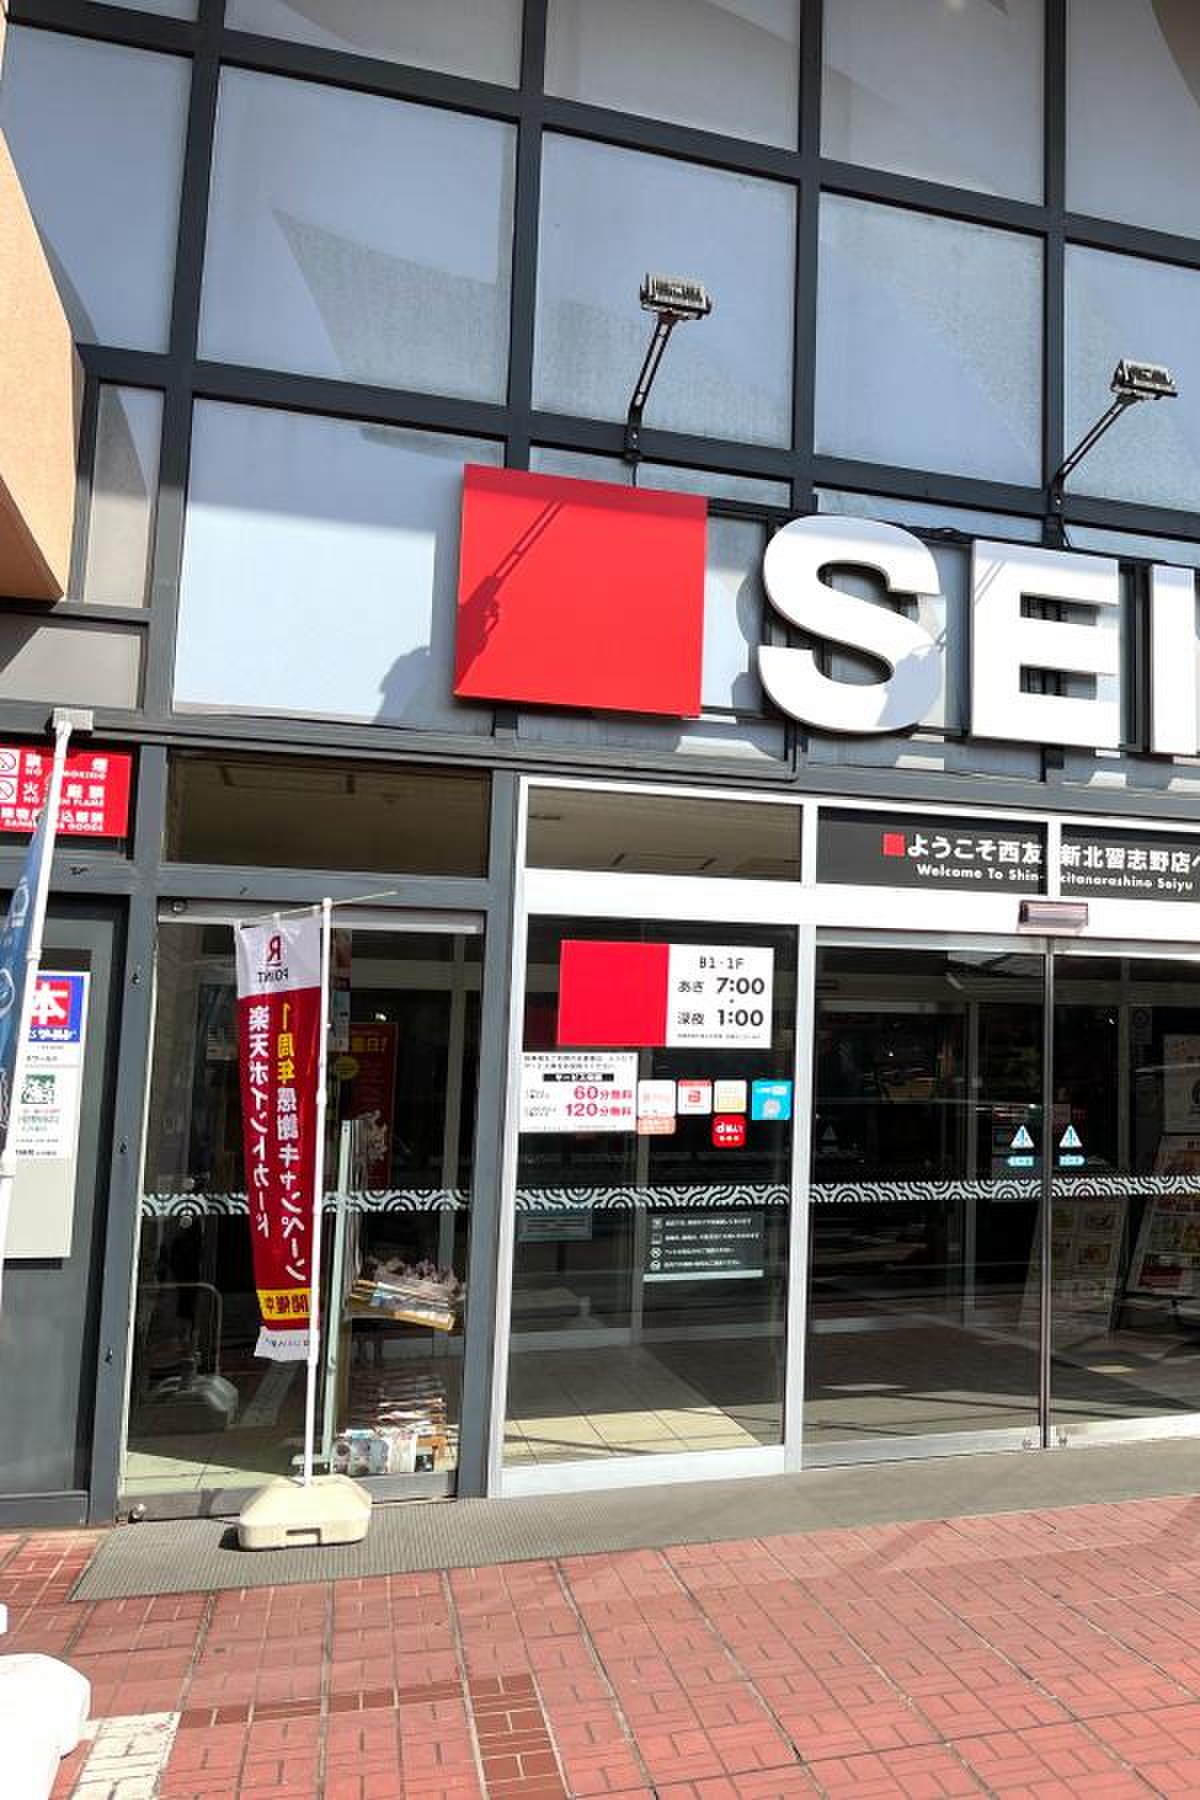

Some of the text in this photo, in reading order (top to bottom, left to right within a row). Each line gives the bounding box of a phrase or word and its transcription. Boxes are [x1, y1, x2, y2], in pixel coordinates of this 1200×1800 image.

[23, 781, 105, 798] 火厳禁
[907, 833, 1043, 865] ようこそ西友
[917, 864, 982, 880] Welcome
[987, 866, 1003, 881] To
[1157, 876, 1194, 892] Seiyu
[677, 976, 765, 996] あさ 7:00
[677, 1008, 764, 1027] 深夜 1:00
